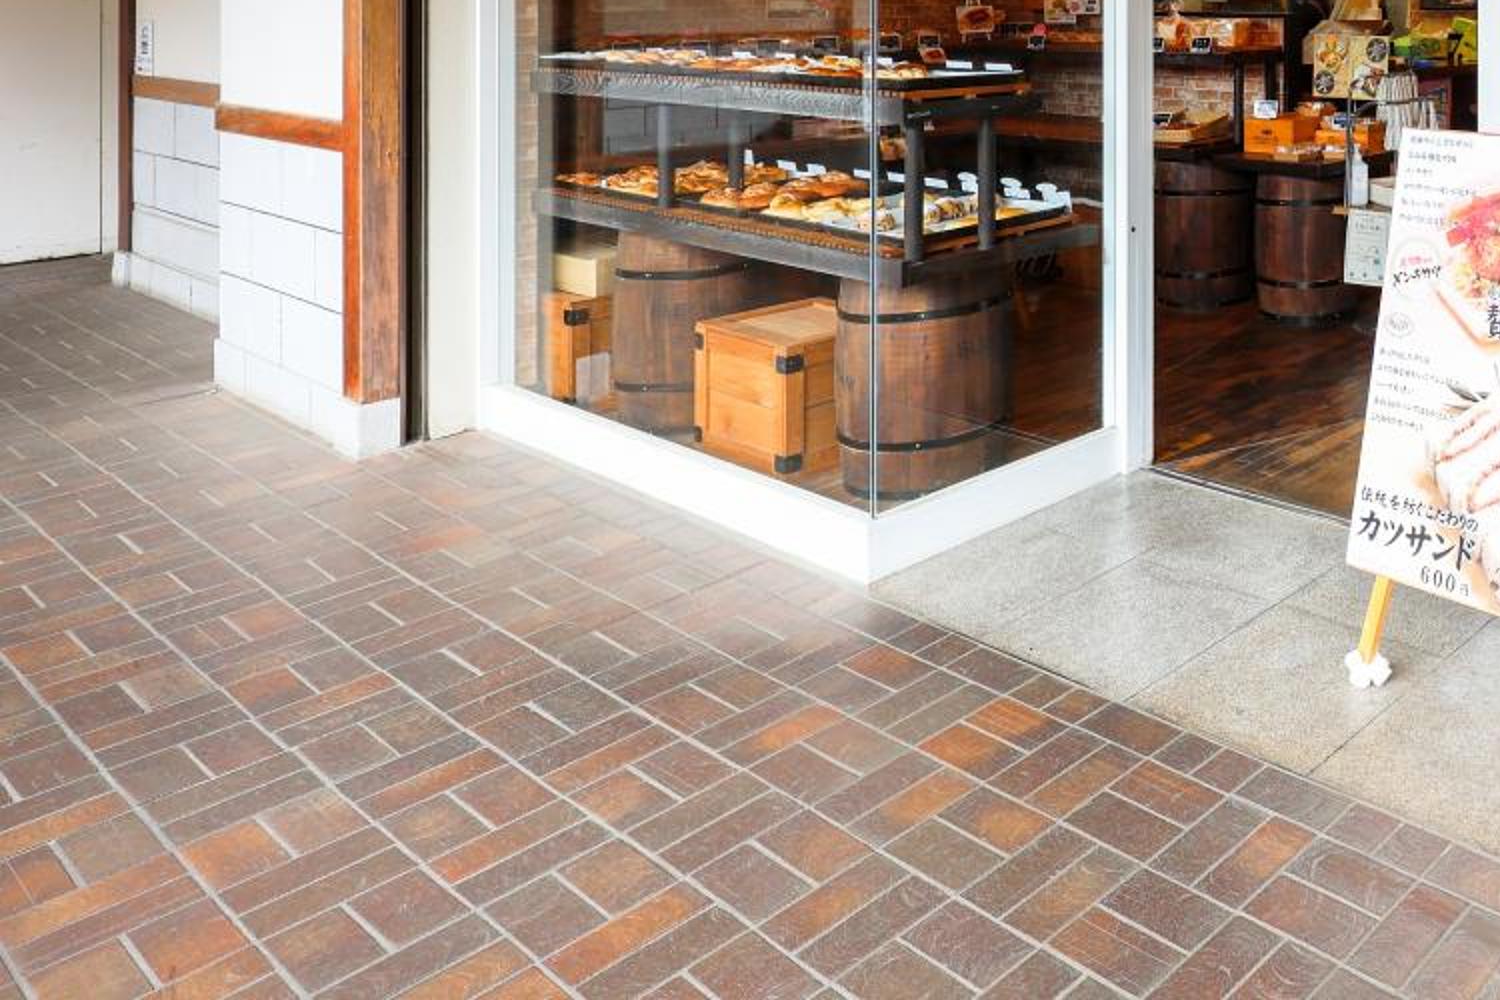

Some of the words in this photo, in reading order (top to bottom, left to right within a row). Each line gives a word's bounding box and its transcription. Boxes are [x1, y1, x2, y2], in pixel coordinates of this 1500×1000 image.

[1357, 510, 1476, 571] カツサンド
